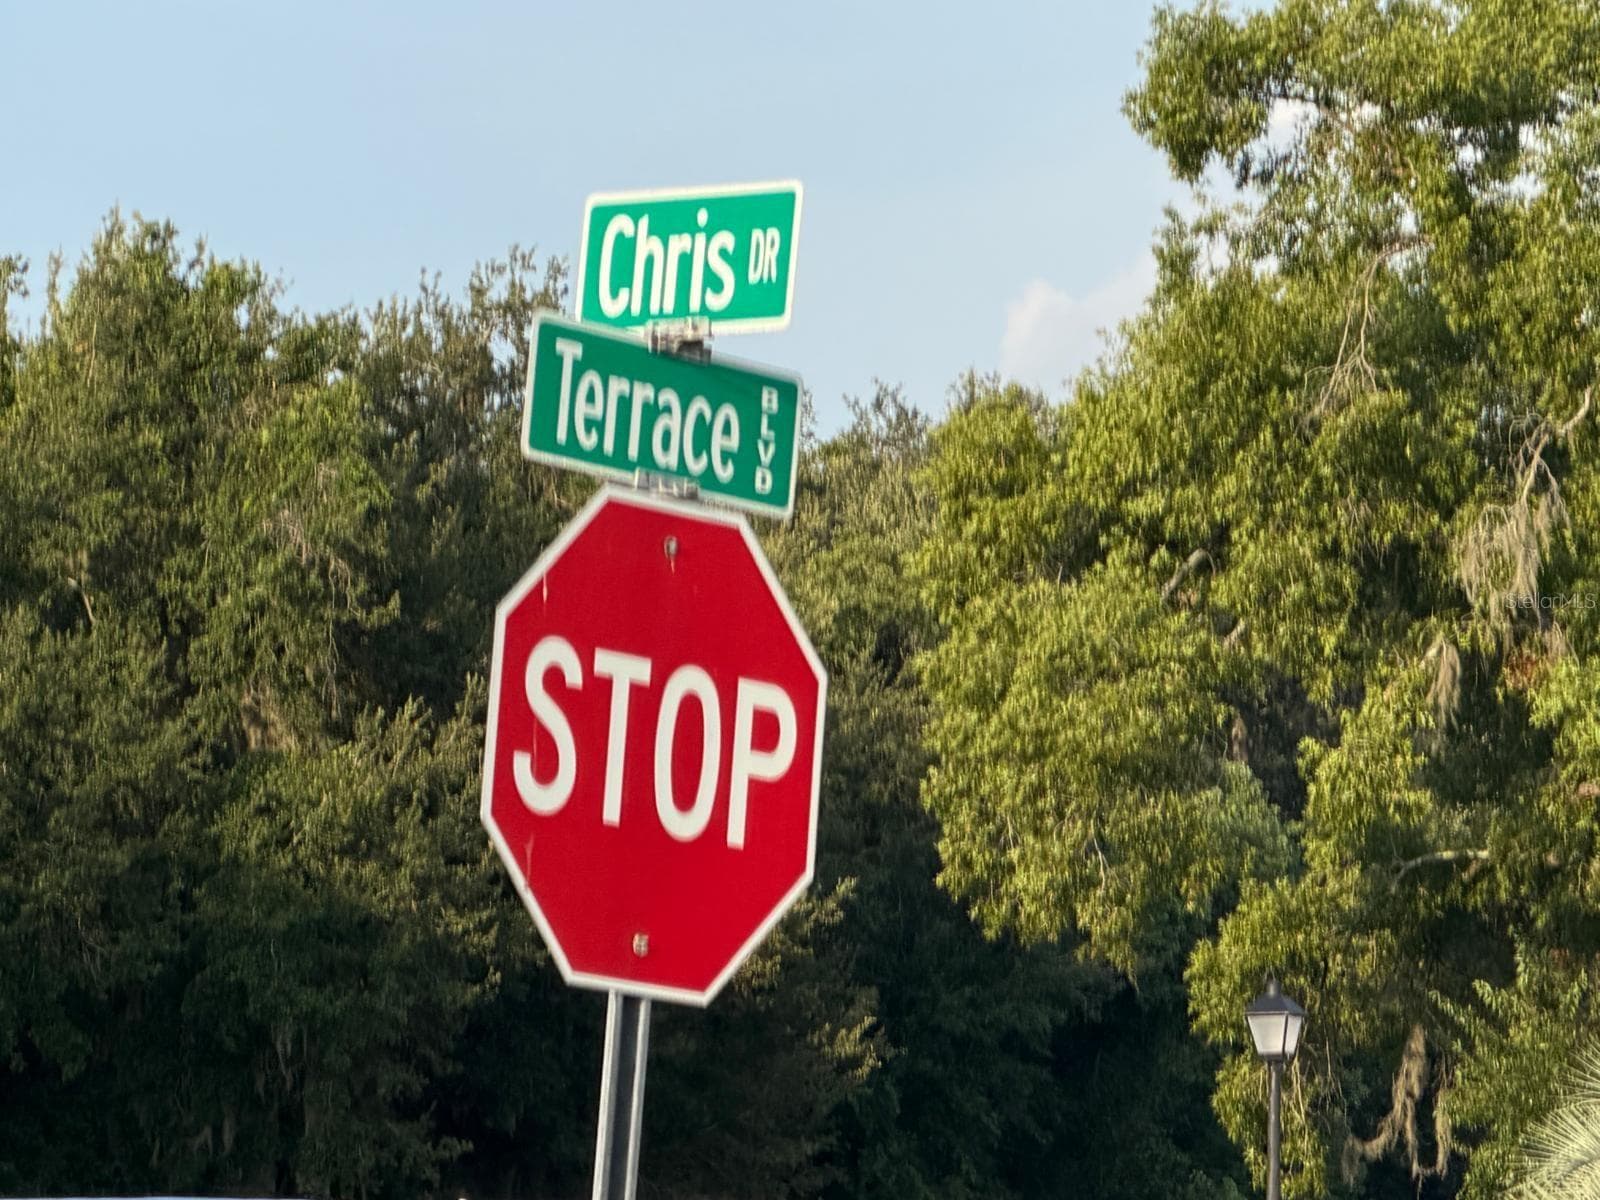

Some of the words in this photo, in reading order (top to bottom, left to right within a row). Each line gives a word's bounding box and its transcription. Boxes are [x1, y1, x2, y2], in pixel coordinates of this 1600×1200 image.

[598, 207, 736, 318] Chris
[748, 227, 781, 285] DR
[555, 337, 741, 483] Terrace
[755, 386, 779, 494] BLVD
[513, 635, 797, 850] STOP
